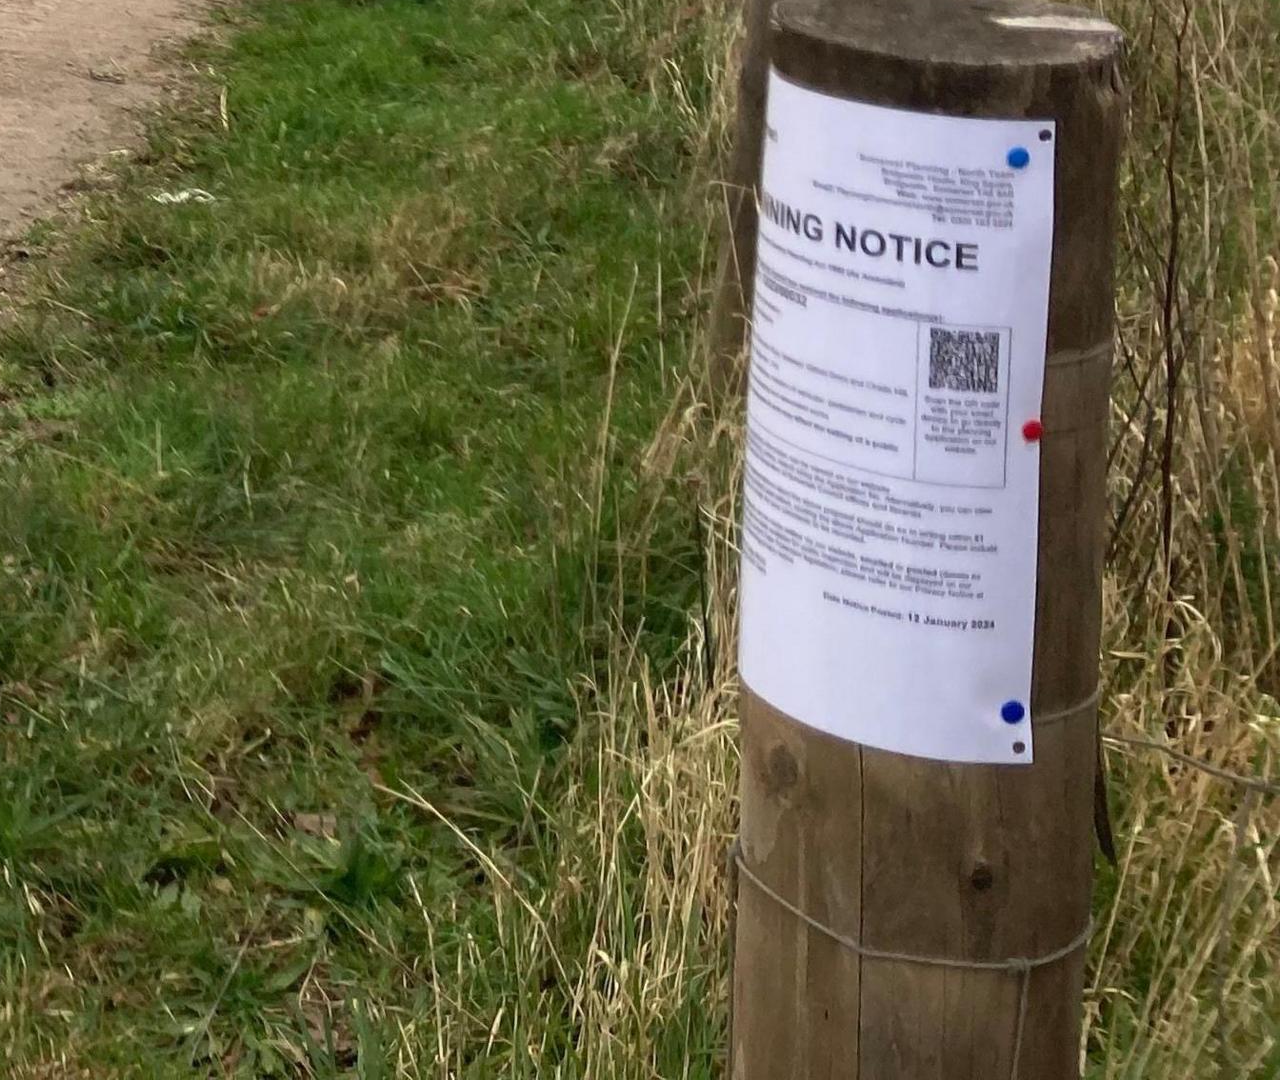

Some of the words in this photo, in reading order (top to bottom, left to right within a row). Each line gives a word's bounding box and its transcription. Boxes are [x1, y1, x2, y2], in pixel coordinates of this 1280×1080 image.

[835, 222, 978, 271] NOTICE
[908, 612, 920, 624] 12
[924, 615, 968, 631] January
